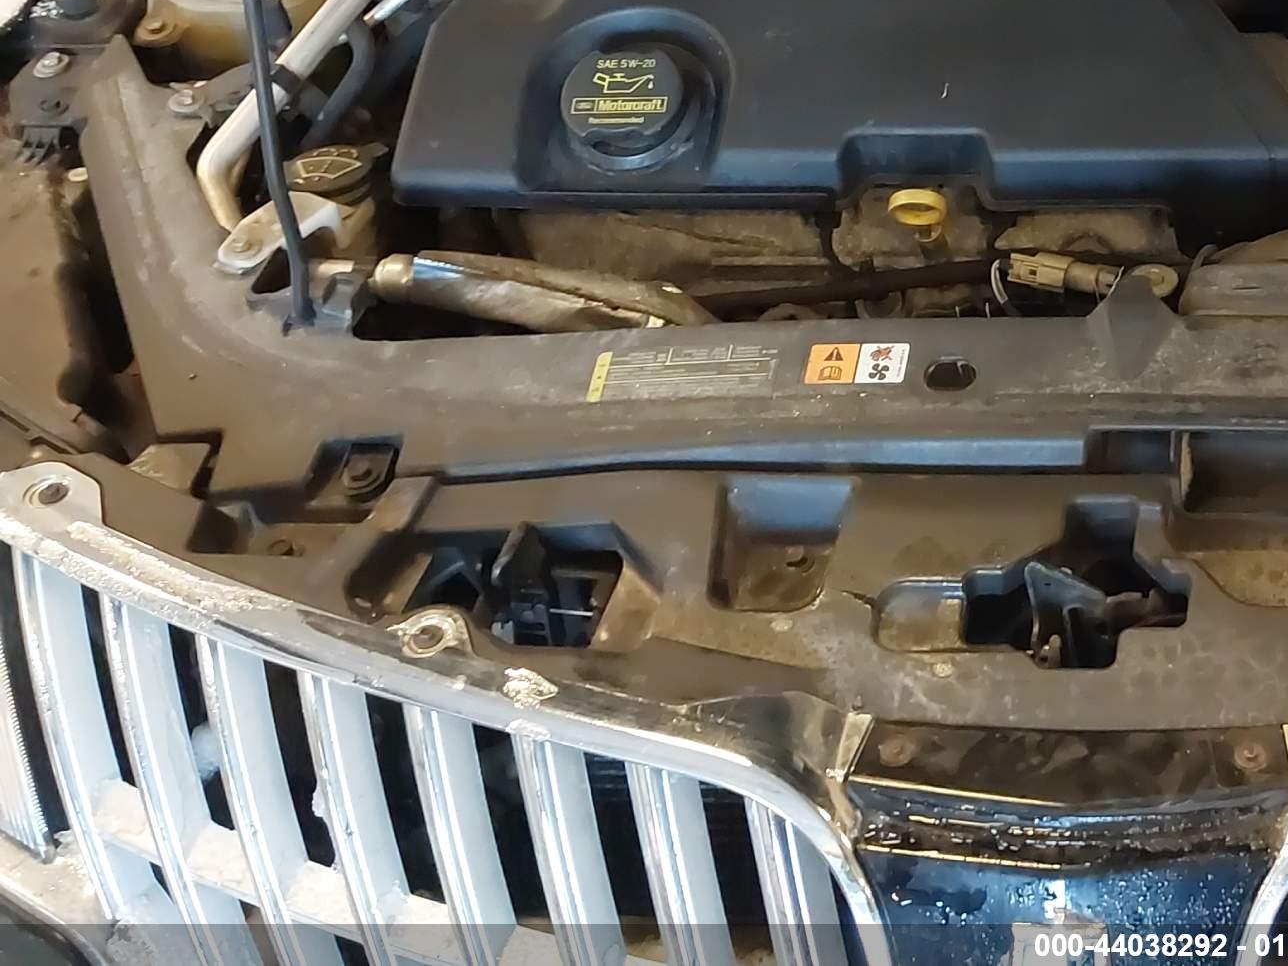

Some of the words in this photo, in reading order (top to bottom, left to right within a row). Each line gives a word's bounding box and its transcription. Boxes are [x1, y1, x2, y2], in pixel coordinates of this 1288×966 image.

[596, 59, 619, 69] SAE
[620, 58, 656, 68] 5W-20
[598, 99, 662, 111] Motorcraft
